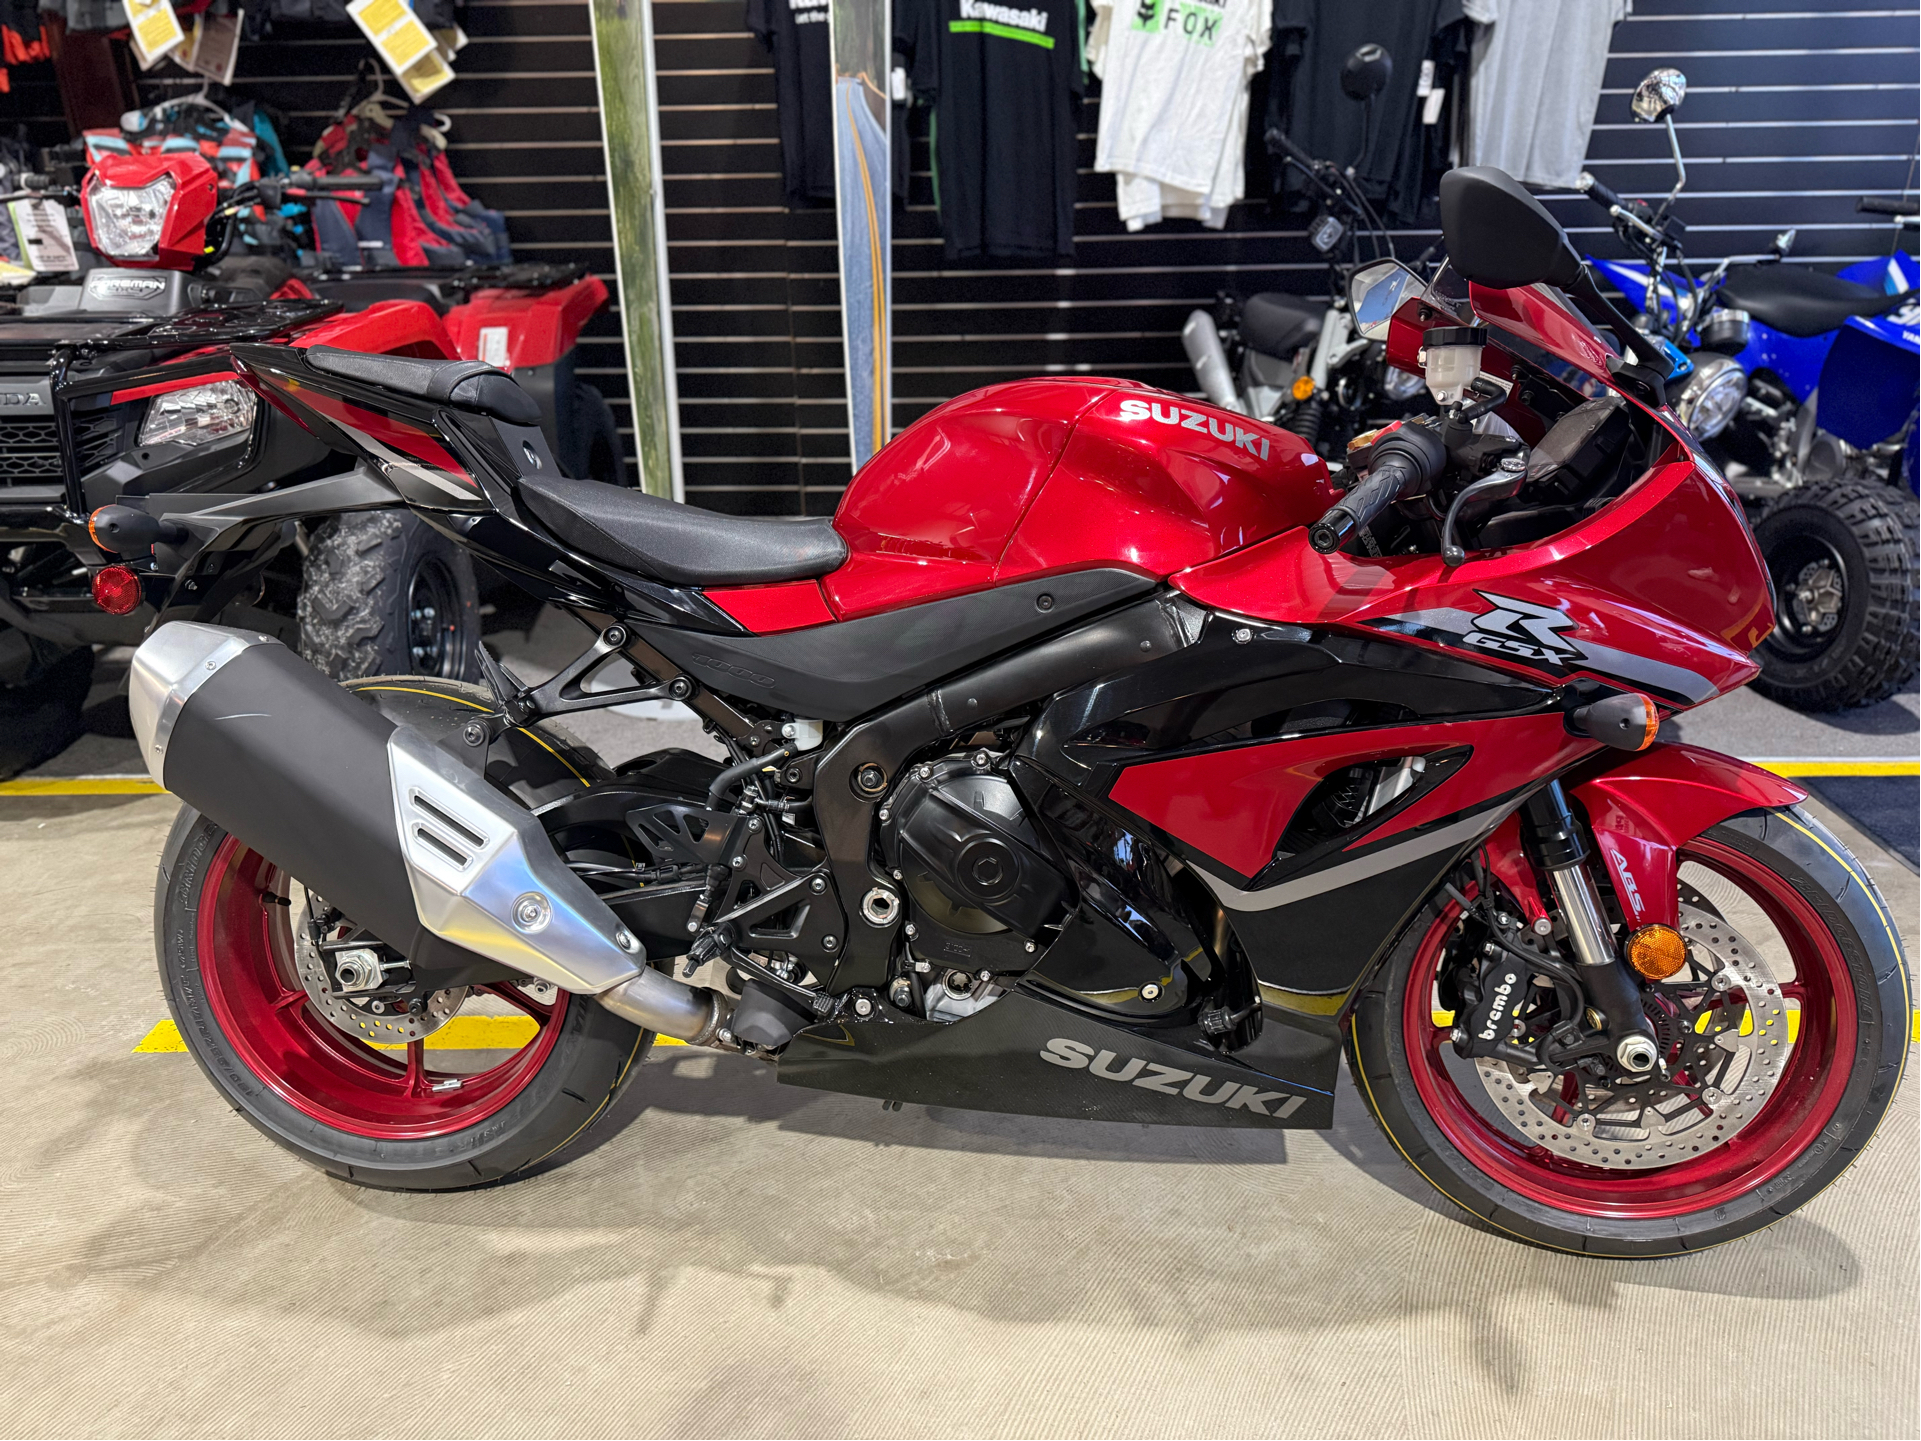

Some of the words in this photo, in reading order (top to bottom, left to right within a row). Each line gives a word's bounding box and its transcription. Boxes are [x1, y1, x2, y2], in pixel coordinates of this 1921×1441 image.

[960, 0, 1048, 33] Kawasaki
[1164, 7, 1218, 41] FOX
[0, 392, 47, 406] DA
[1119, 399, 1270, 461] SUZUKI
[1462, 631, 1577, 666] GSX
[1610, 848, 1646, 917] ABS
[1478, 973, 1517, 1040] brembo
[1039, 1037, 1308, 1119] SUZUKI
